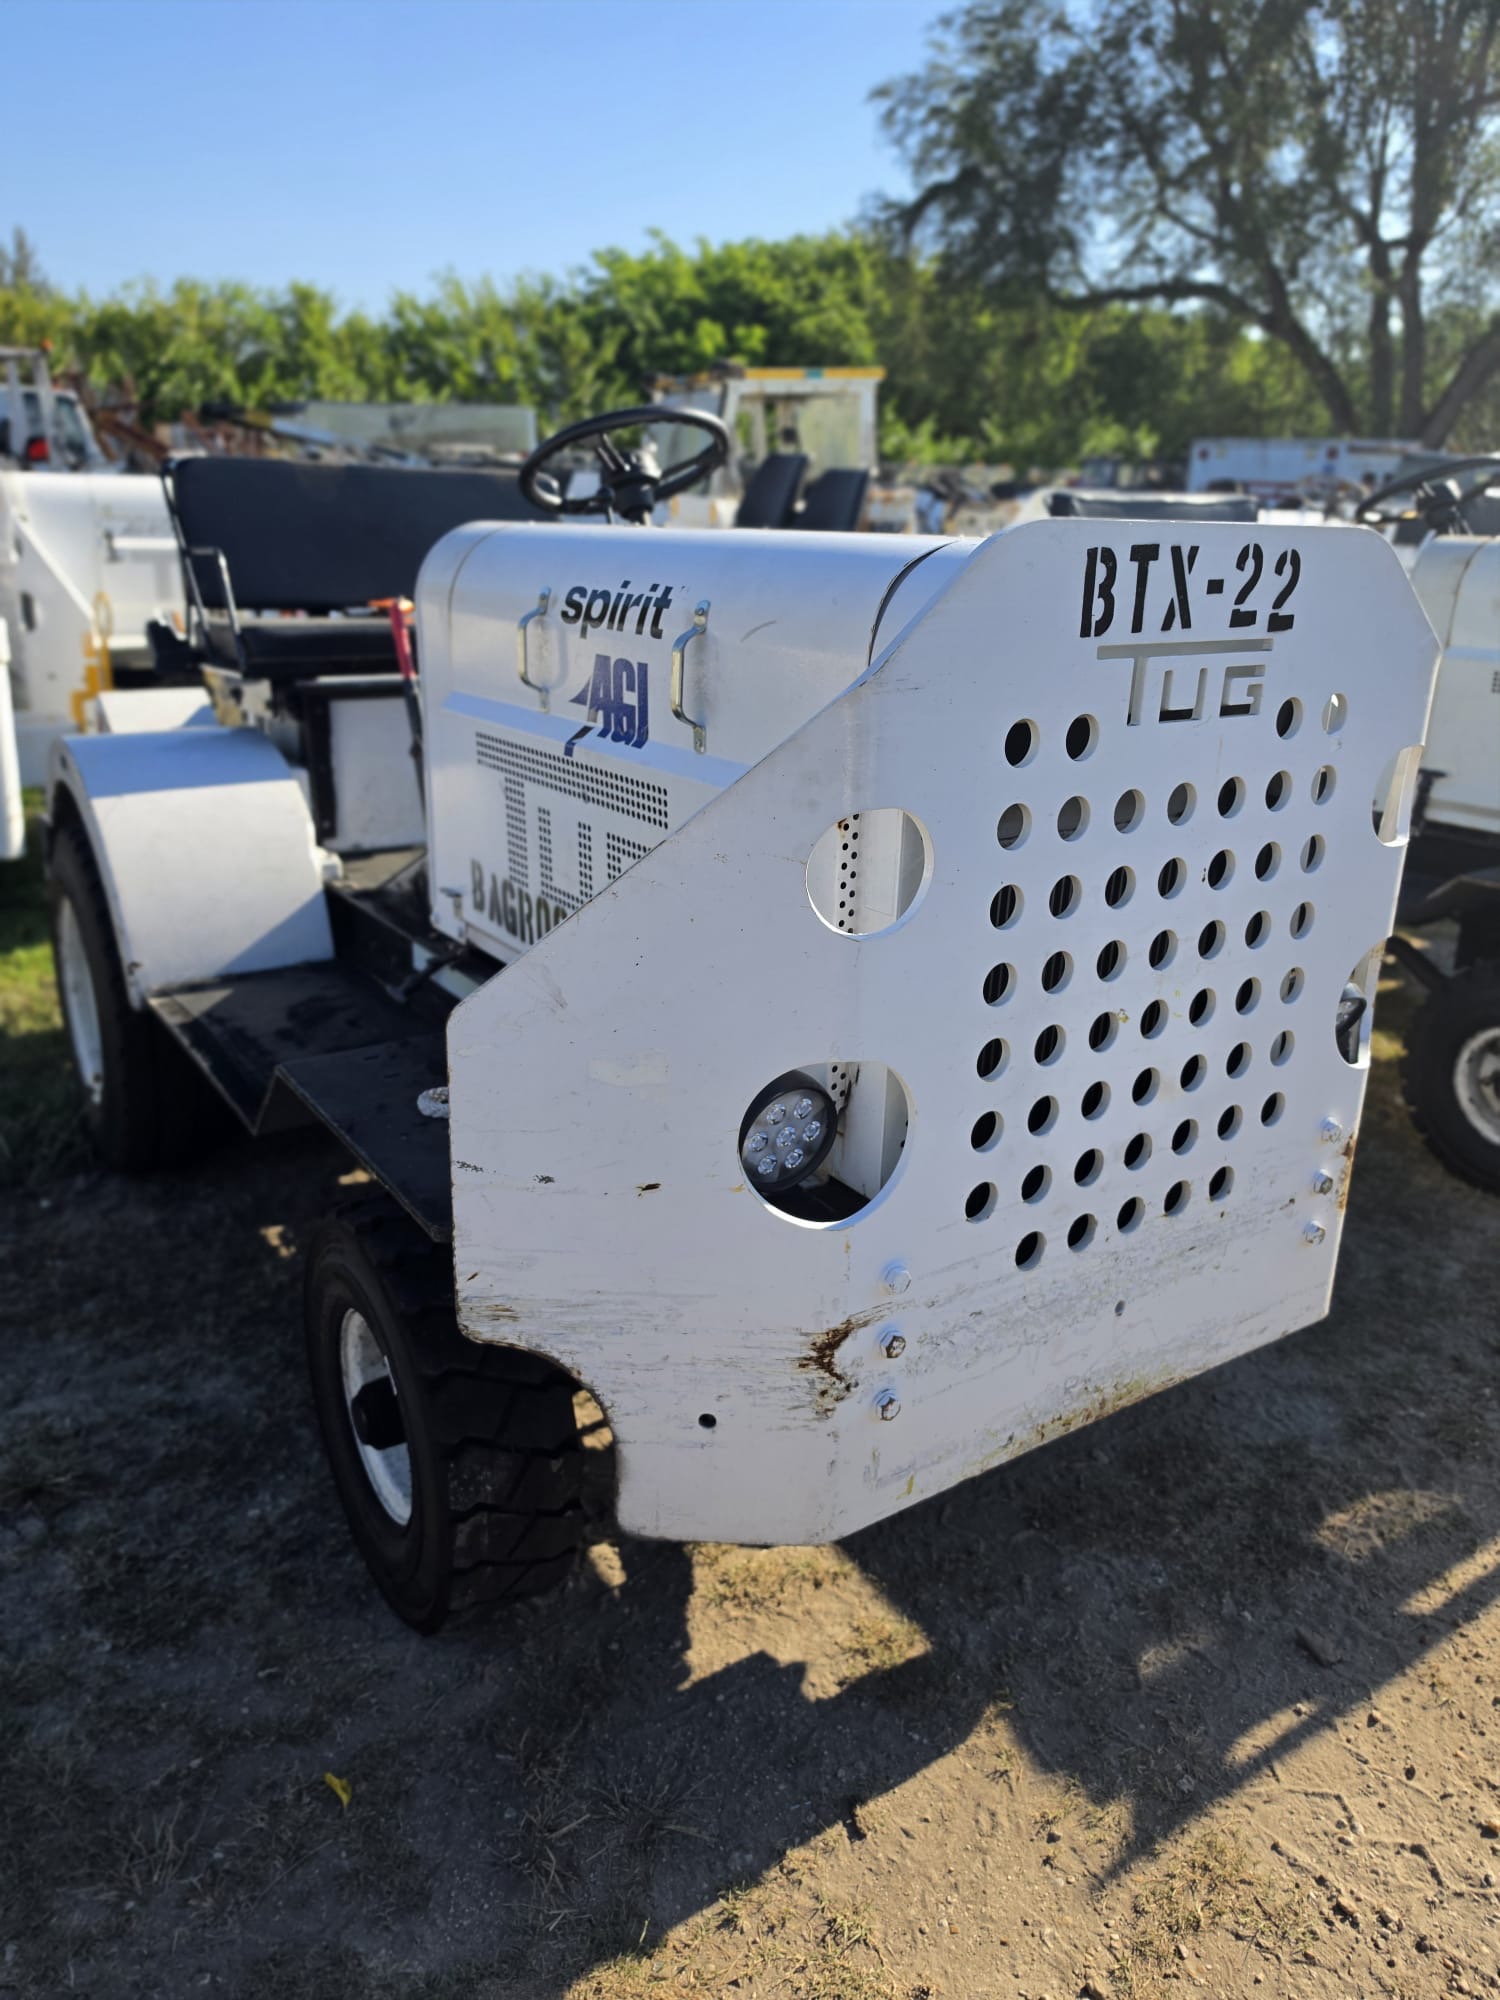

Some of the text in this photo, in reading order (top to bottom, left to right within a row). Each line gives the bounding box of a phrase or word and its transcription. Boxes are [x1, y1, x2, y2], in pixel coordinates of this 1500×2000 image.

[560, 580, 673, 639] spirit
[1079, 543, 1301, 638] BTX-22
[1097, 637, 1274, 727] TUG
